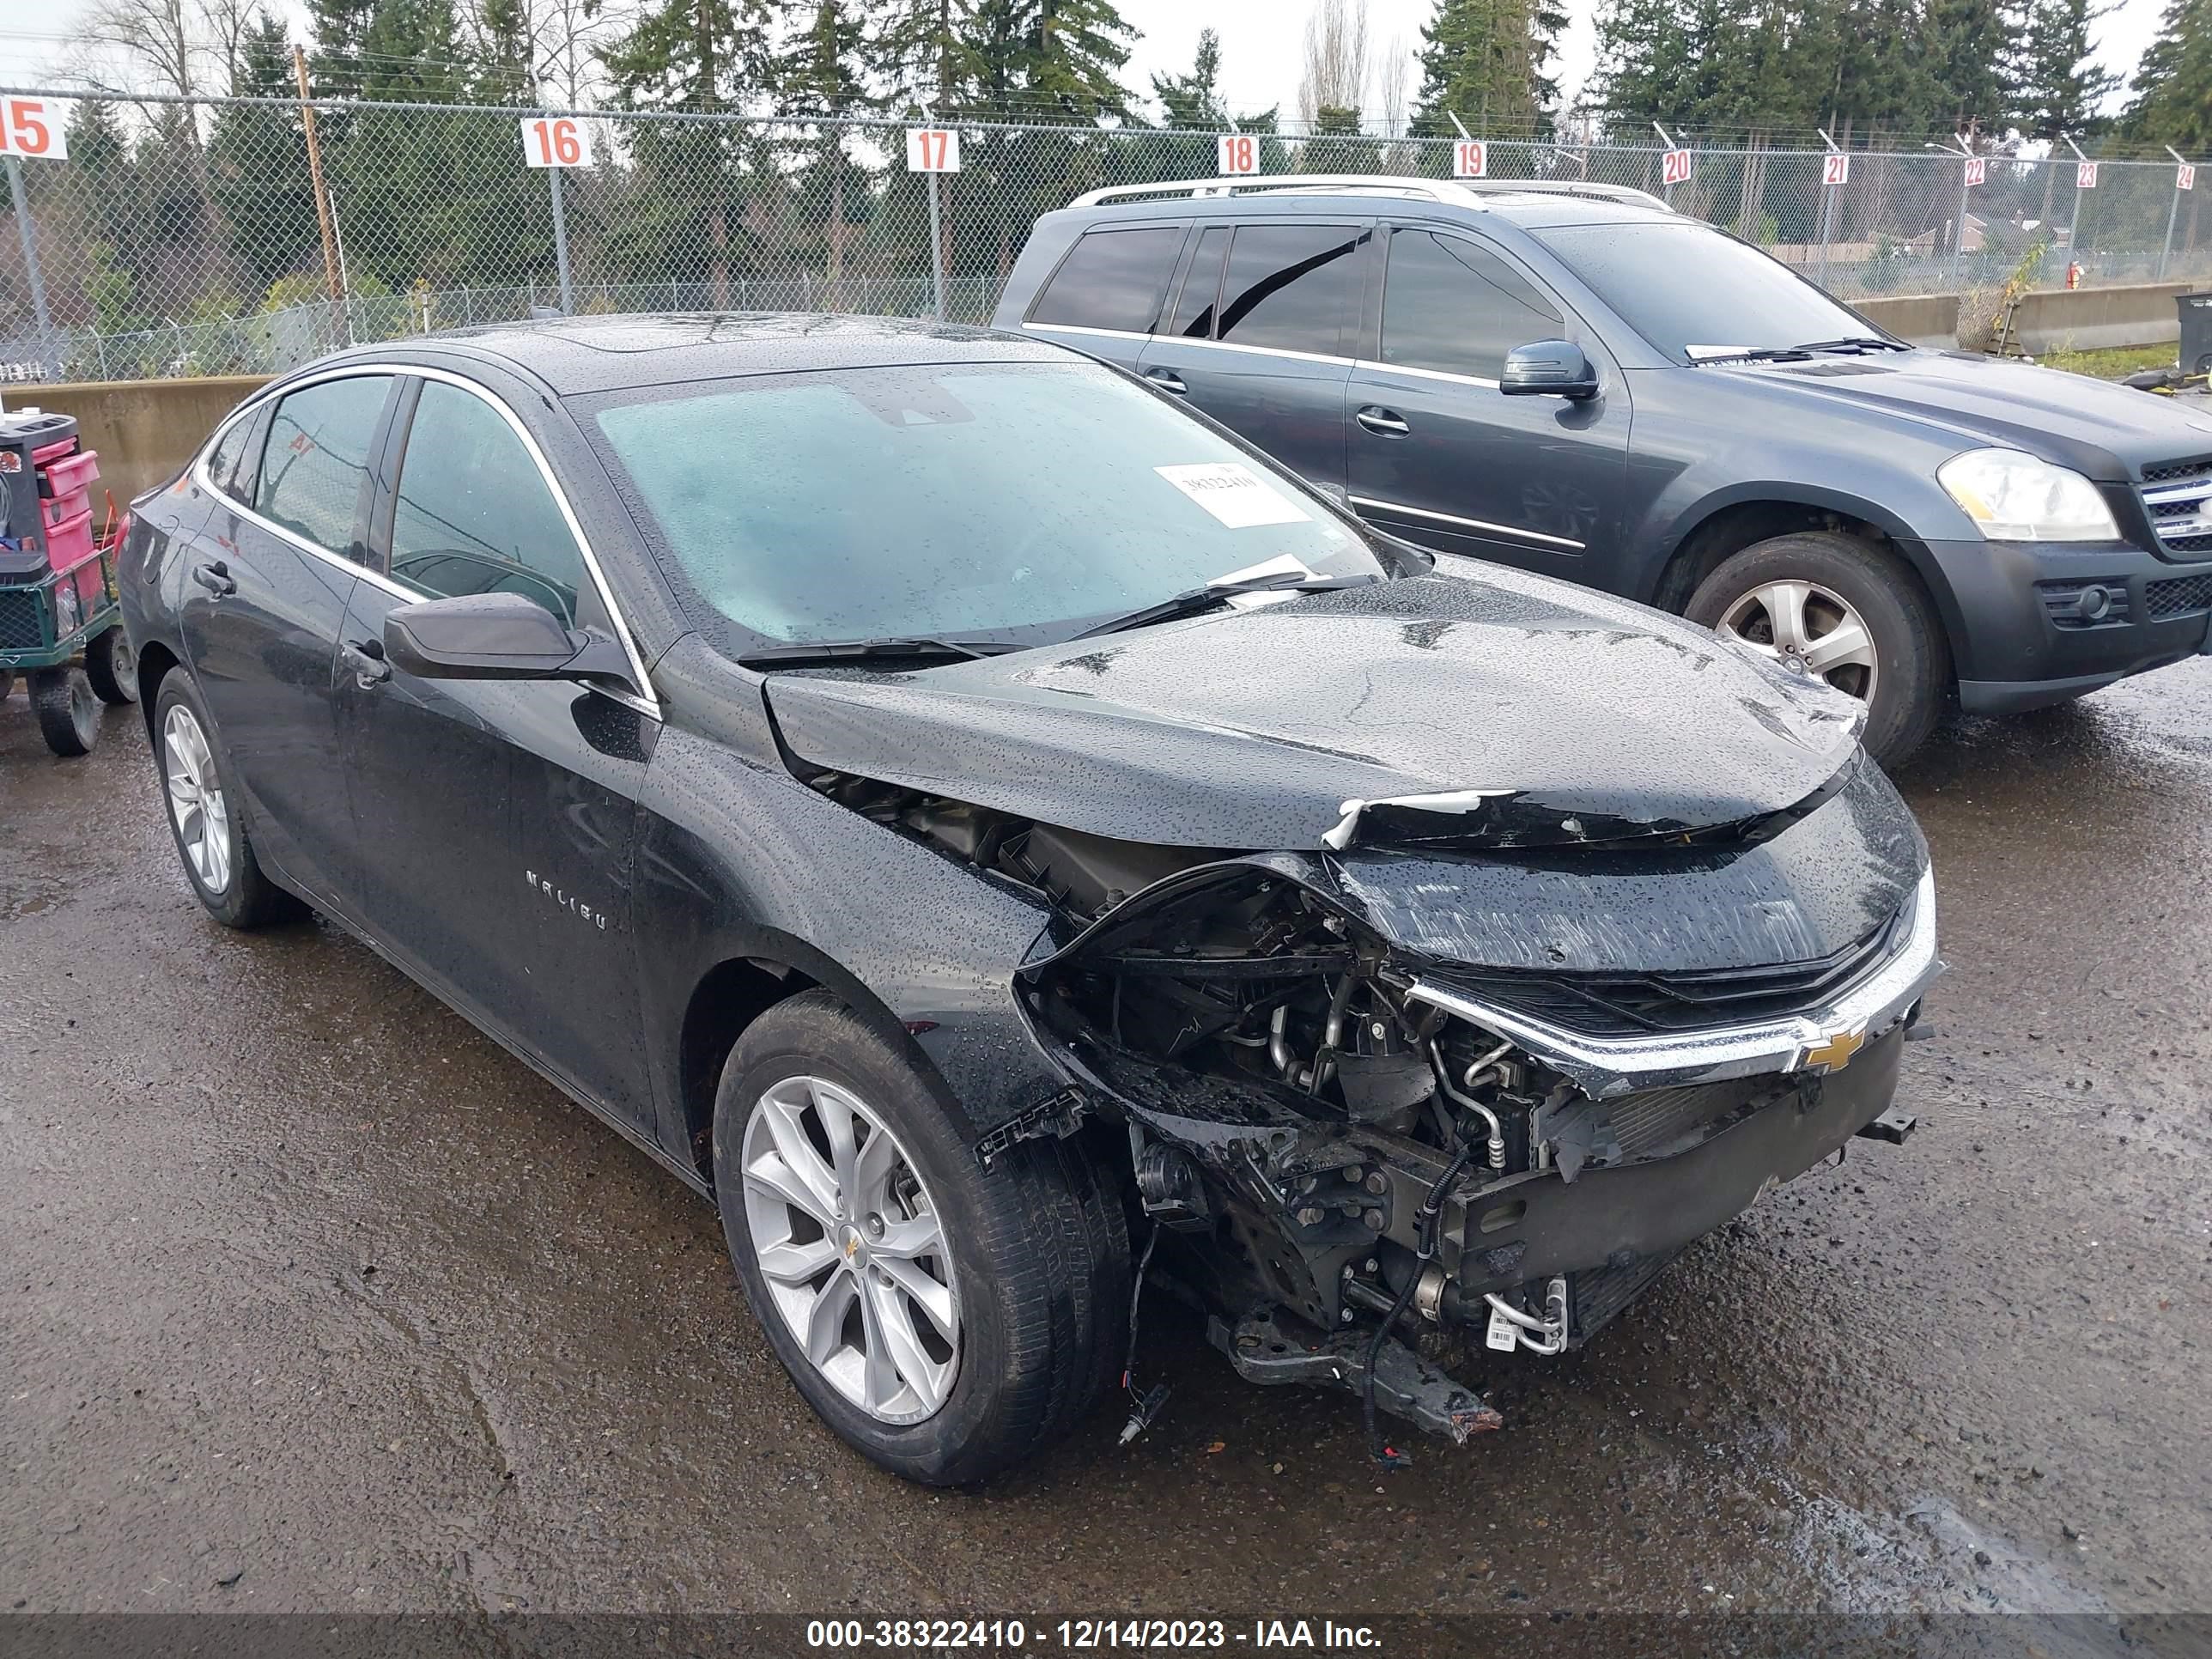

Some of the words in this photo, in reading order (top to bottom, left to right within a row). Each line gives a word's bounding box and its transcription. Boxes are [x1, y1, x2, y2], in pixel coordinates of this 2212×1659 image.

[532, 119, 580, 164] 16
[919, 132, 947, 169] 17
[1225, 137, 1251, 172] 18
[1459, 144, 1481, 174] 19
[1666, 152, 1688, 182] 20
[1826, 157, 1844, 183] 21
[1966, 160, 1983, 185] 22
[2079, 165, 2094, 186] 23
[2178, 167, 2192, 188] 24
[526, 870, 605, 930] MALIBU
